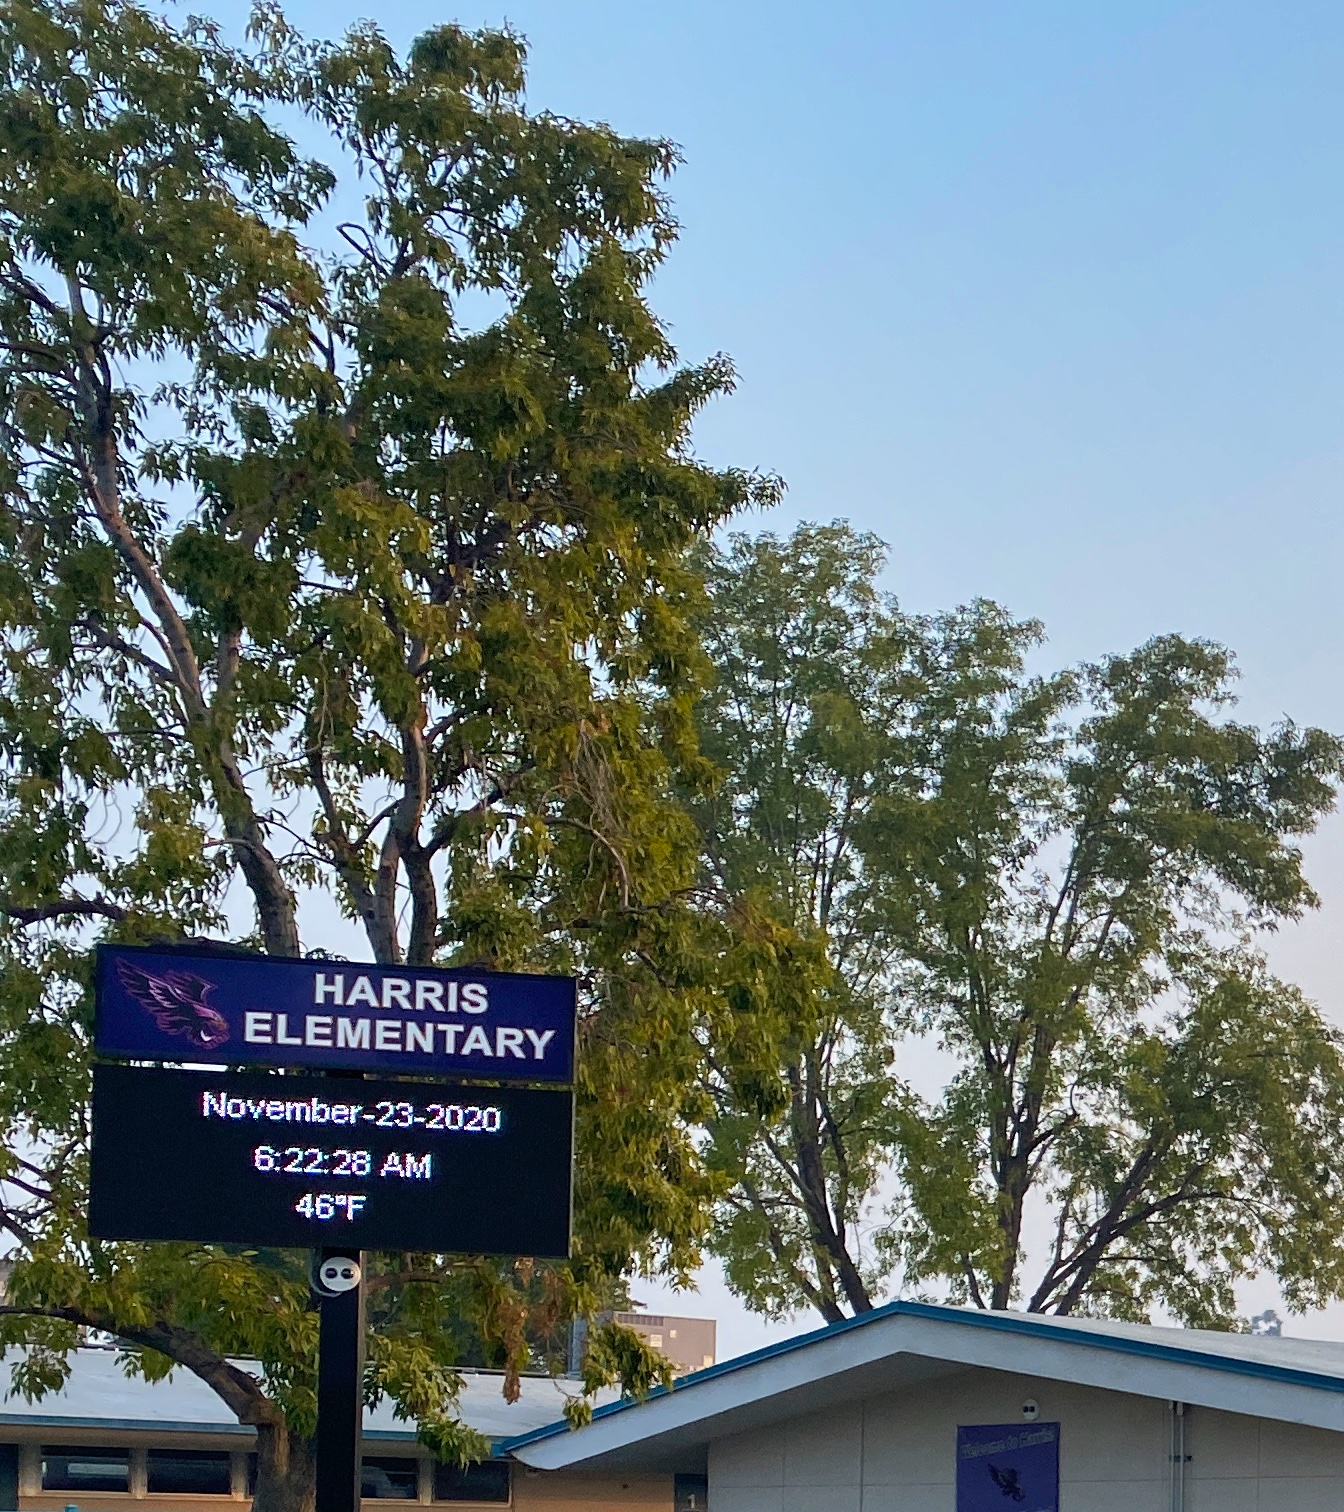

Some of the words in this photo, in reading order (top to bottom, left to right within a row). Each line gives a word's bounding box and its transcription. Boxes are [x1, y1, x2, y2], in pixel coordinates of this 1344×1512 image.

[315, 973, 488, 1014] HARRIS
[243, 1011, 556, 1060] ELEMENTARY
[202, 1091, 502, 1132] November-23-2020
[253, 1145, 371, 1176] 6:22:28
[380, 1153, 433, 1179] AM
